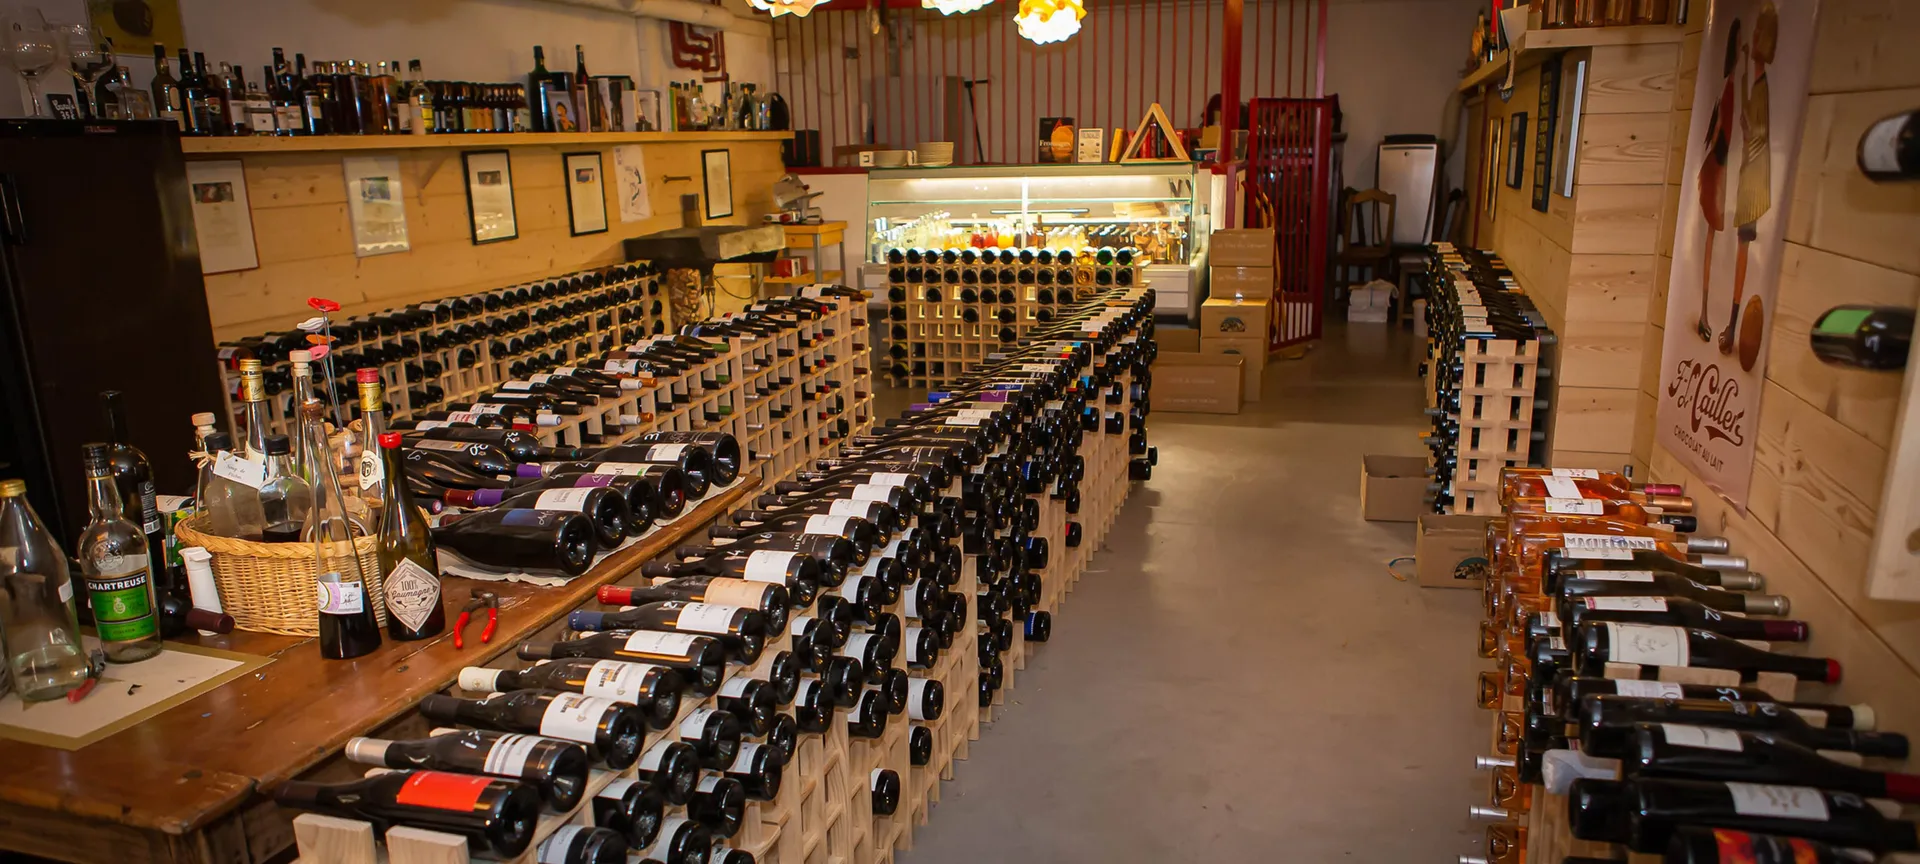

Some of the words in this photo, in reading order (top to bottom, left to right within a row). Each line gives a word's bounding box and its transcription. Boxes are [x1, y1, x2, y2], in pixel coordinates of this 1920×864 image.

[1674, 424, 1703, 455] CHOCOLAT
[1701, 448, 1711, 463] AU
[1709, 455, 1724, 473] LAIT
[87, 575, 147, 591] CHARTREUSE
[401, 579, 419, 592] 100%
